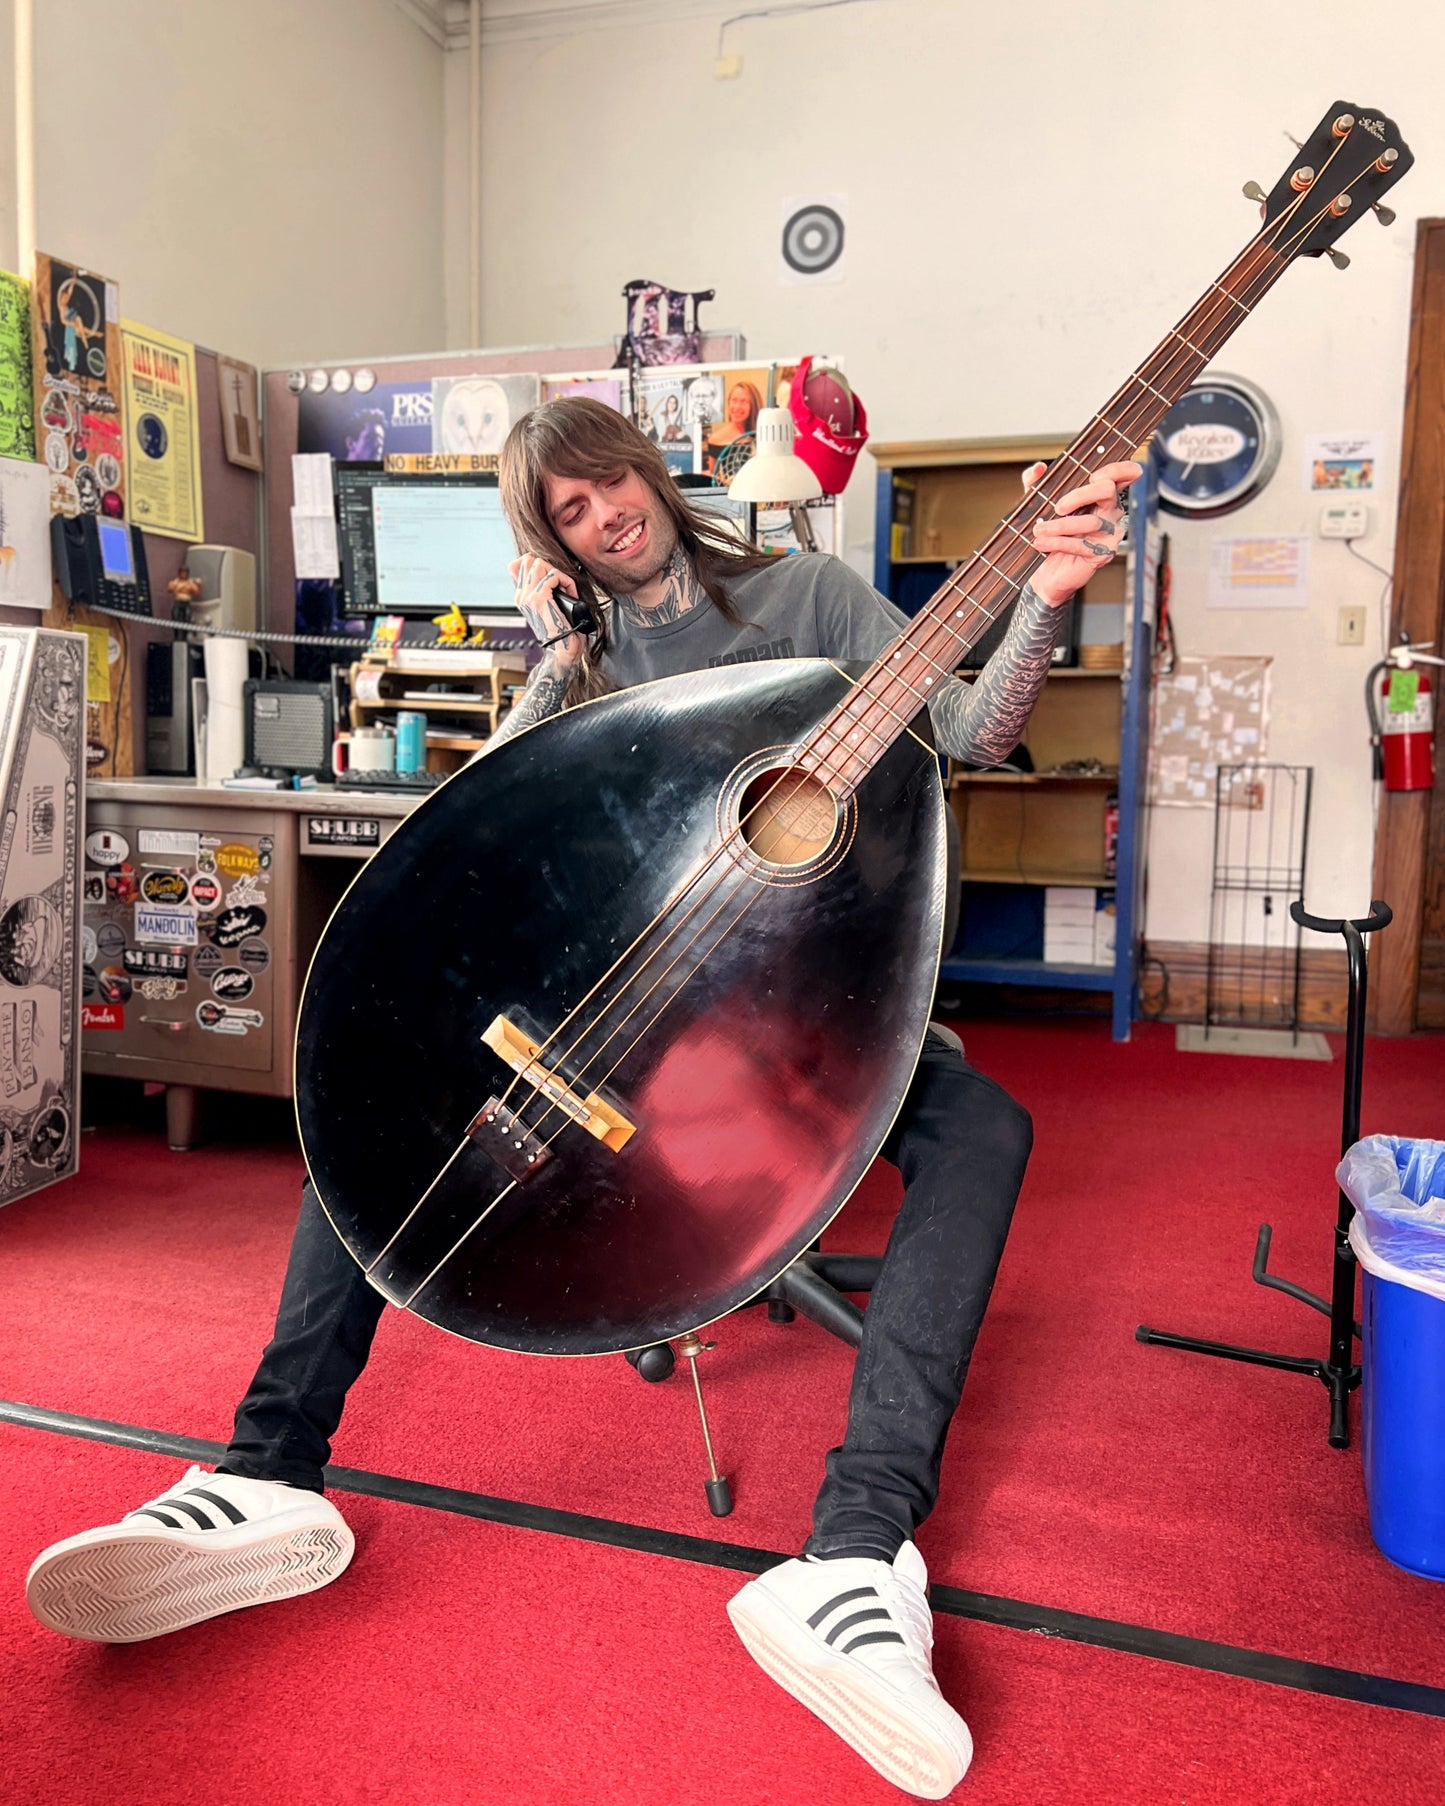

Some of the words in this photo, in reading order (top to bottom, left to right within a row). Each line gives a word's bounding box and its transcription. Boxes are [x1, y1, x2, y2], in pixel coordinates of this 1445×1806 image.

[392, 393, 433, 417] PRS
[385, 456, 405, 470] NO
[416, 455, 460, 470] HEAVY
[310, 820, 378, 836] SHUBB
[65, 793, 77, 884] COMPANY
[93, 847, 121, 860] happy
[64, 890, 75, 958] BANJO
[138, 916, 196, 936] MANDOLIN
[125, 950, 186, 969] SHUBB
[82, 1007, 116, 1026] Fender
[21, 1007, 34, 1080] BANJO
